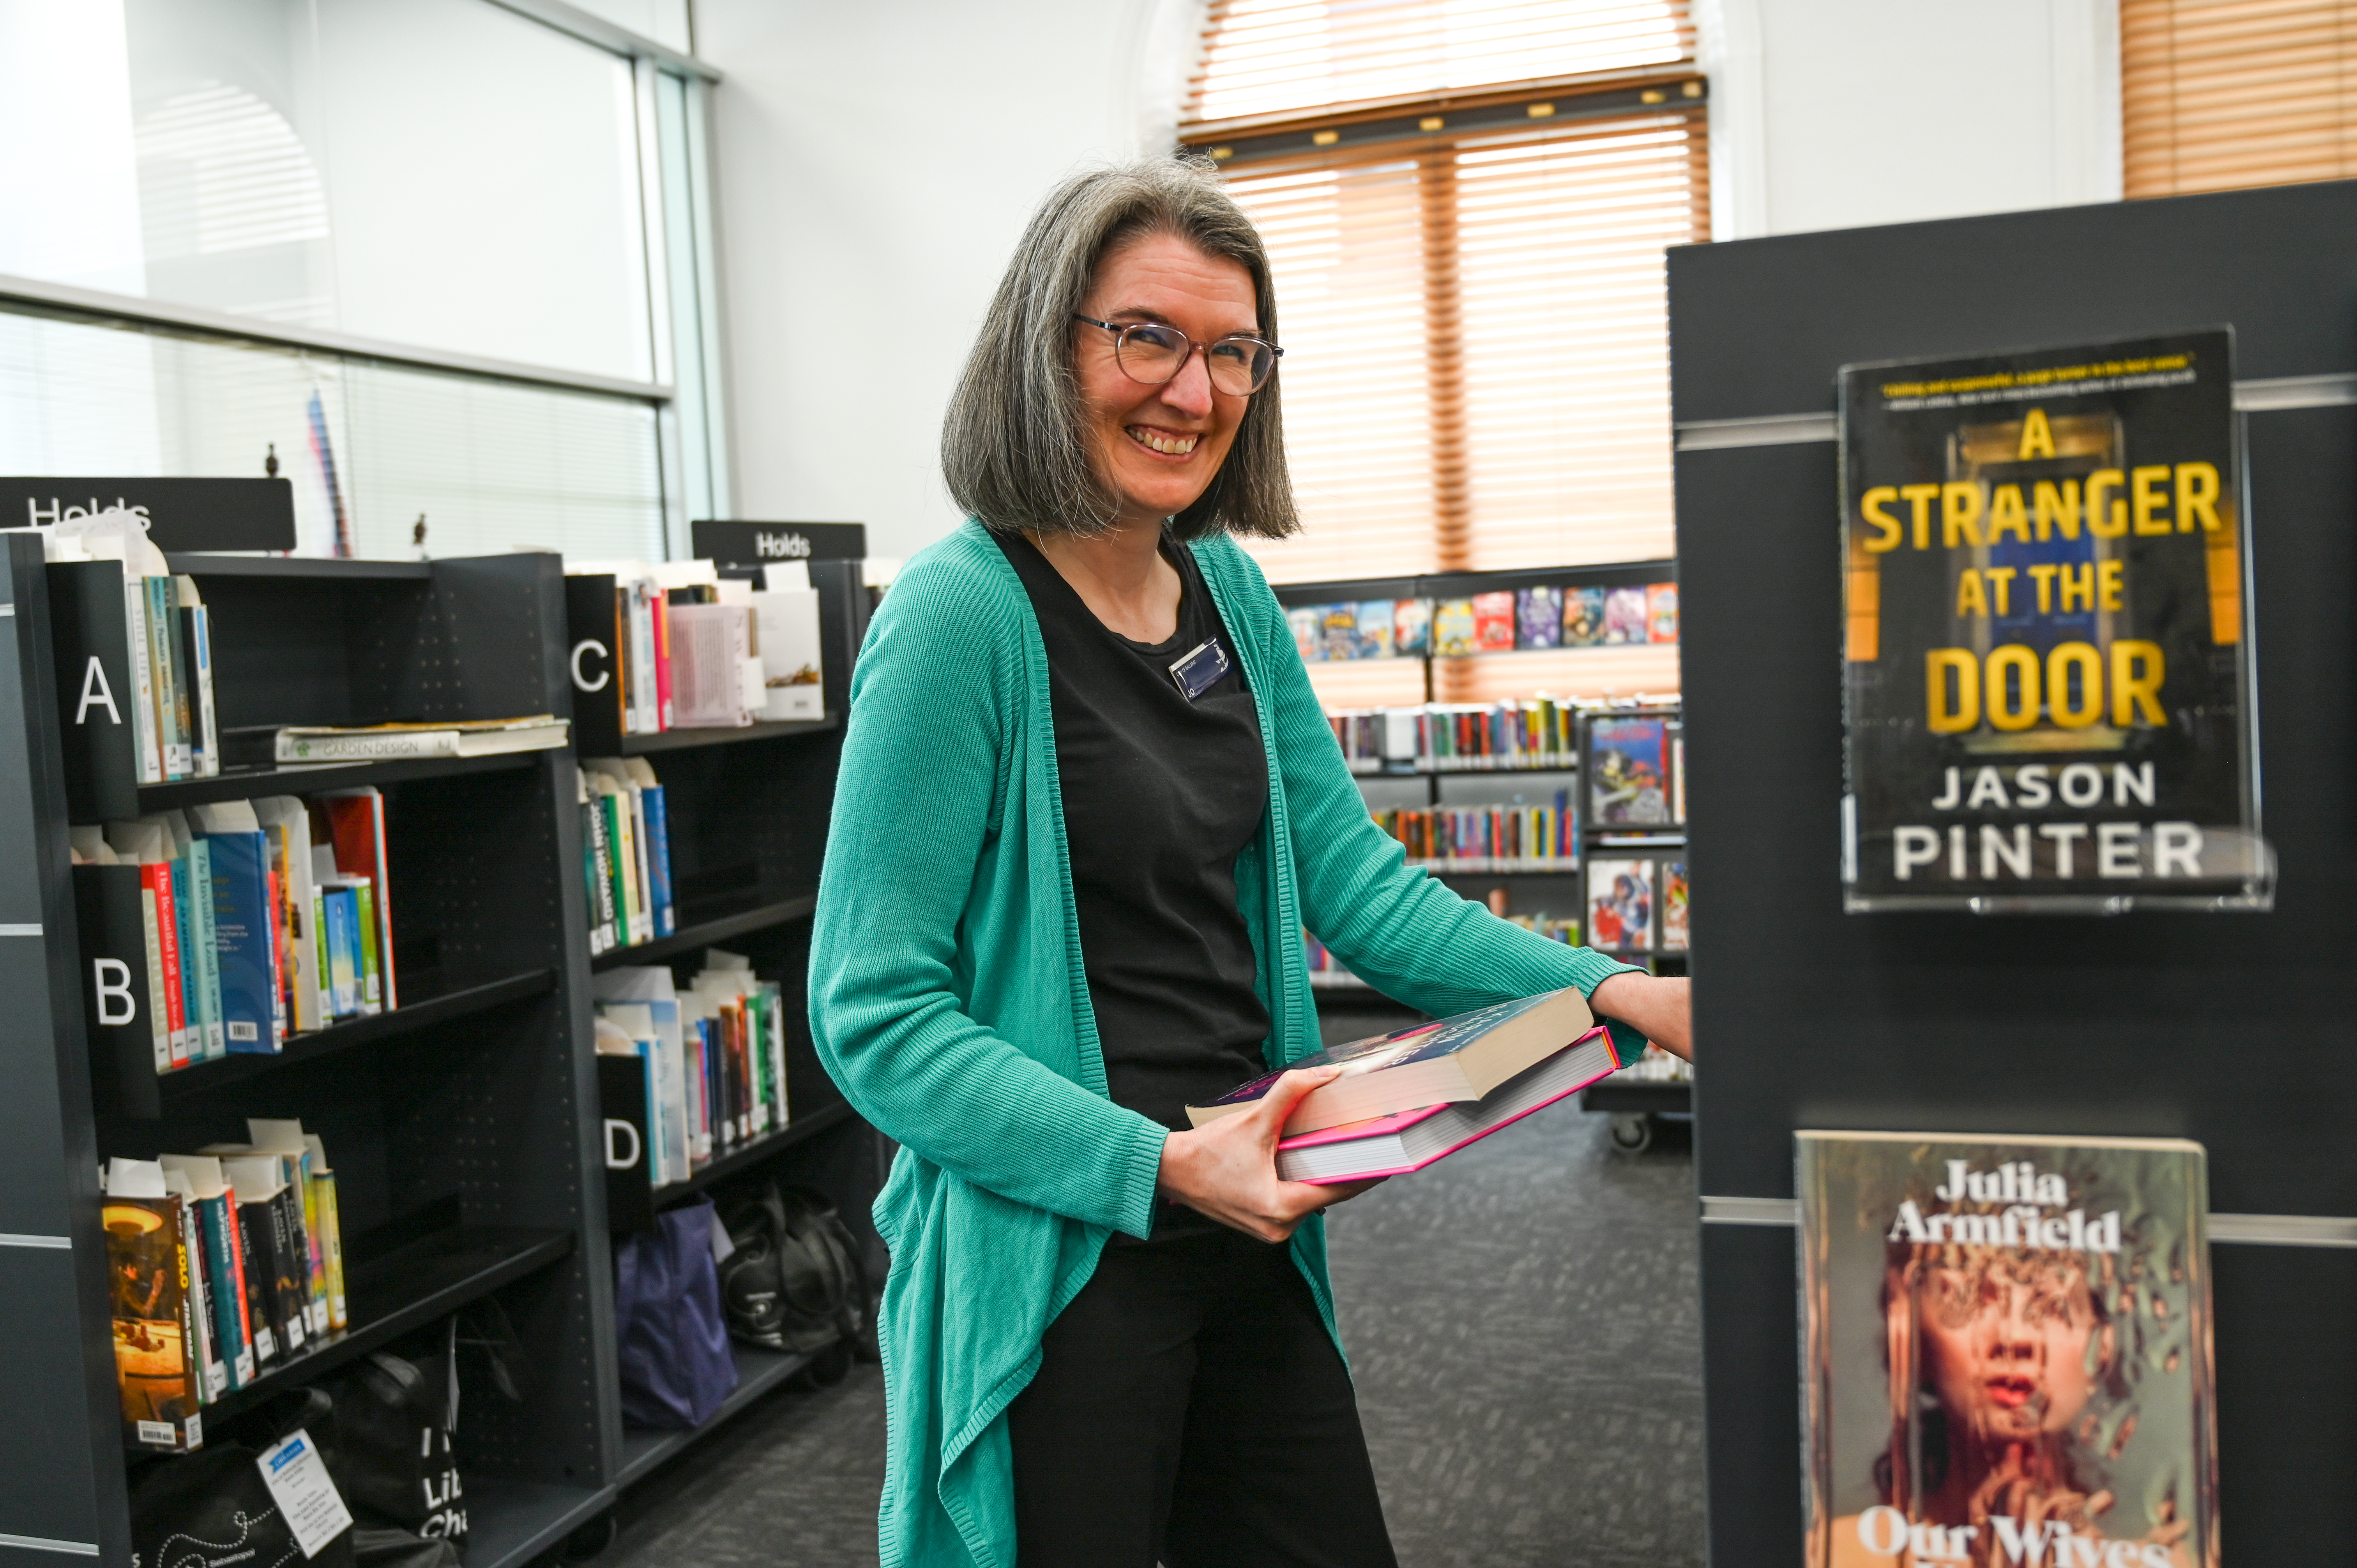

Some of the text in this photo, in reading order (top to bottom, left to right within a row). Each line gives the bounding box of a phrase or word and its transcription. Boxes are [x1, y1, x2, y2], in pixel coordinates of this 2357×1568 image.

[2019, 409, 2055, 459] A
[1861, 462, 2221, 553] STRANGER
[755, 531, 811, 558] Holds
[1957, 560, 2124, 618] AT THE
[75, 655, 122, 725] A
[571, 639, 609, 692] C
[1925, 639, 2167, 733] DOOR
[1188, 688, 1195, 698] JO
[375, 739, 419, 754] DESIGN
[1933, 761, 2156, 810] JASON
[1894, 822, 2203, 881] PINTER
[94, 958, 136, 1026] B
[1383, 1004, 1507, 1067] SLAUGHTER
[1437, 1010, 1509, 1044] KARIN
[604, 1119, 640, 1169] D
[1936, 1159, 2067, 1204] Julia
[1889, 1201, 2120, 1252] Armfield
[177, 1244, 190, 1289] SOLO
[182, 1299, 191, 1328] STAR
[186, 1329, 195, 1360] WARS
[1857, 1505, 2172, 1568] Our Wives
